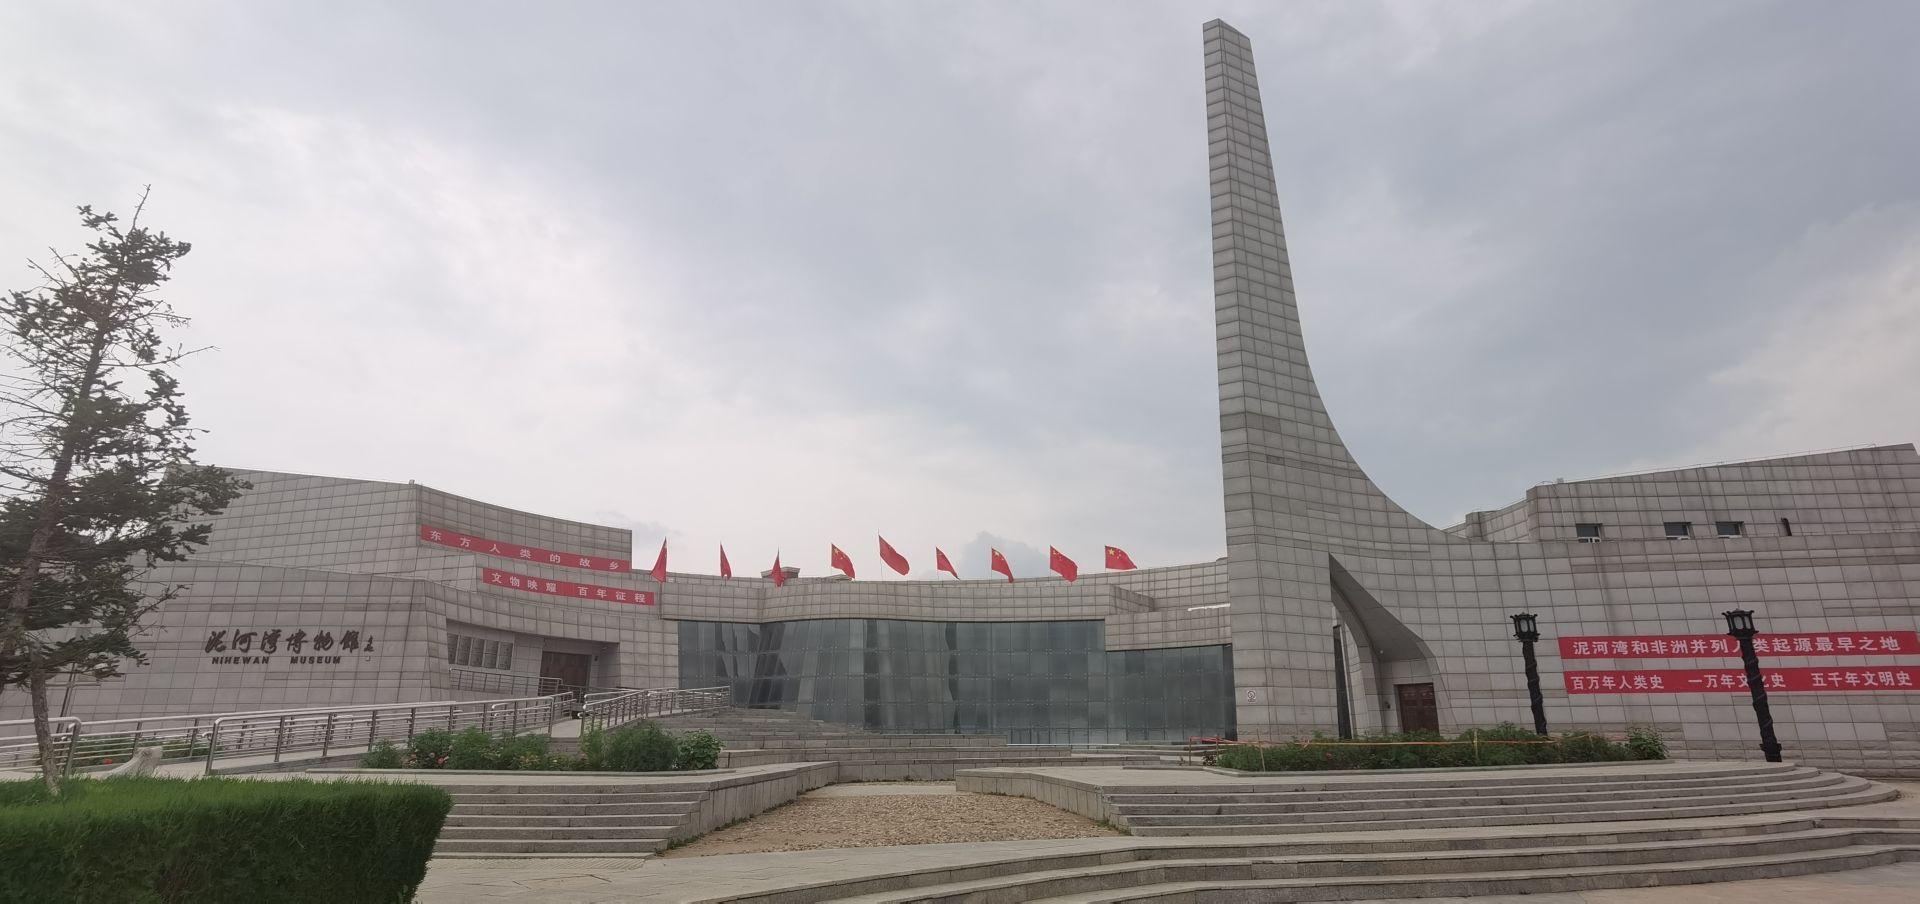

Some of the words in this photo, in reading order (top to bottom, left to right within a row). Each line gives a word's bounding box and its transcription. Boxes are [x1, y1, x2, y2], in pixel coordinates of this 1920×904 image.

[430, 530, 619, 570] 东方人类的故乡
[491, 572, 557, 593] 文物映耀
[577, 586, 645, 603] 百年征程
[204, 628, 360, 654] 泥河湾博物馆
[211, 656, 270, 665] NIHEWAN
[289, 655, 342, 665] MUSEUM
[1570, 674, 1665, 690] 百万年人类史
[1811, 670, 1913, 688] 五千年文明史
